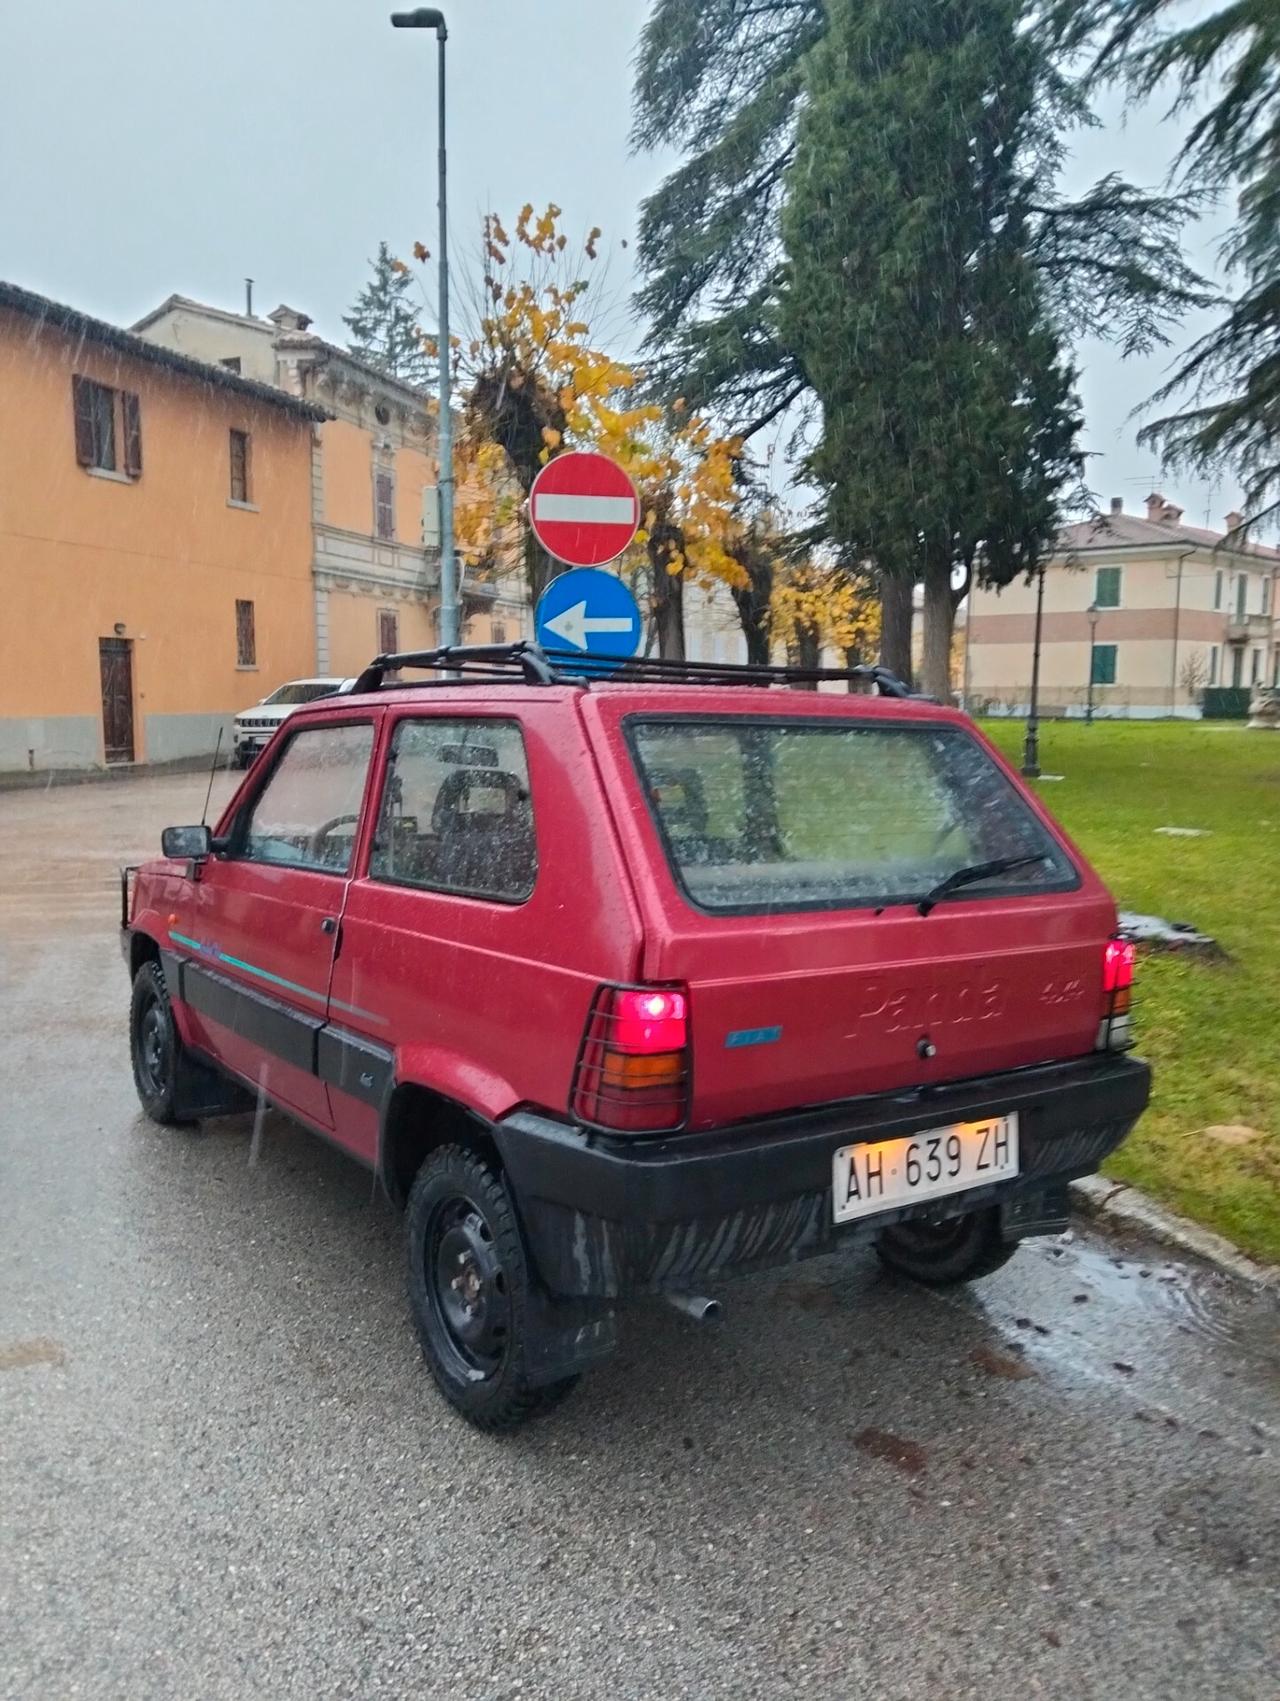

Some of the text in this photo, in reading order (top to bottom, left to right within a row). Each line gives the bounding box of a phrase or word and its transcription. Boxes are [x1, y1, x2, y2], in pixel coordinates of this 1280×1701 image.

[846, 1122, 1010, 1203] AH 639 ZH
